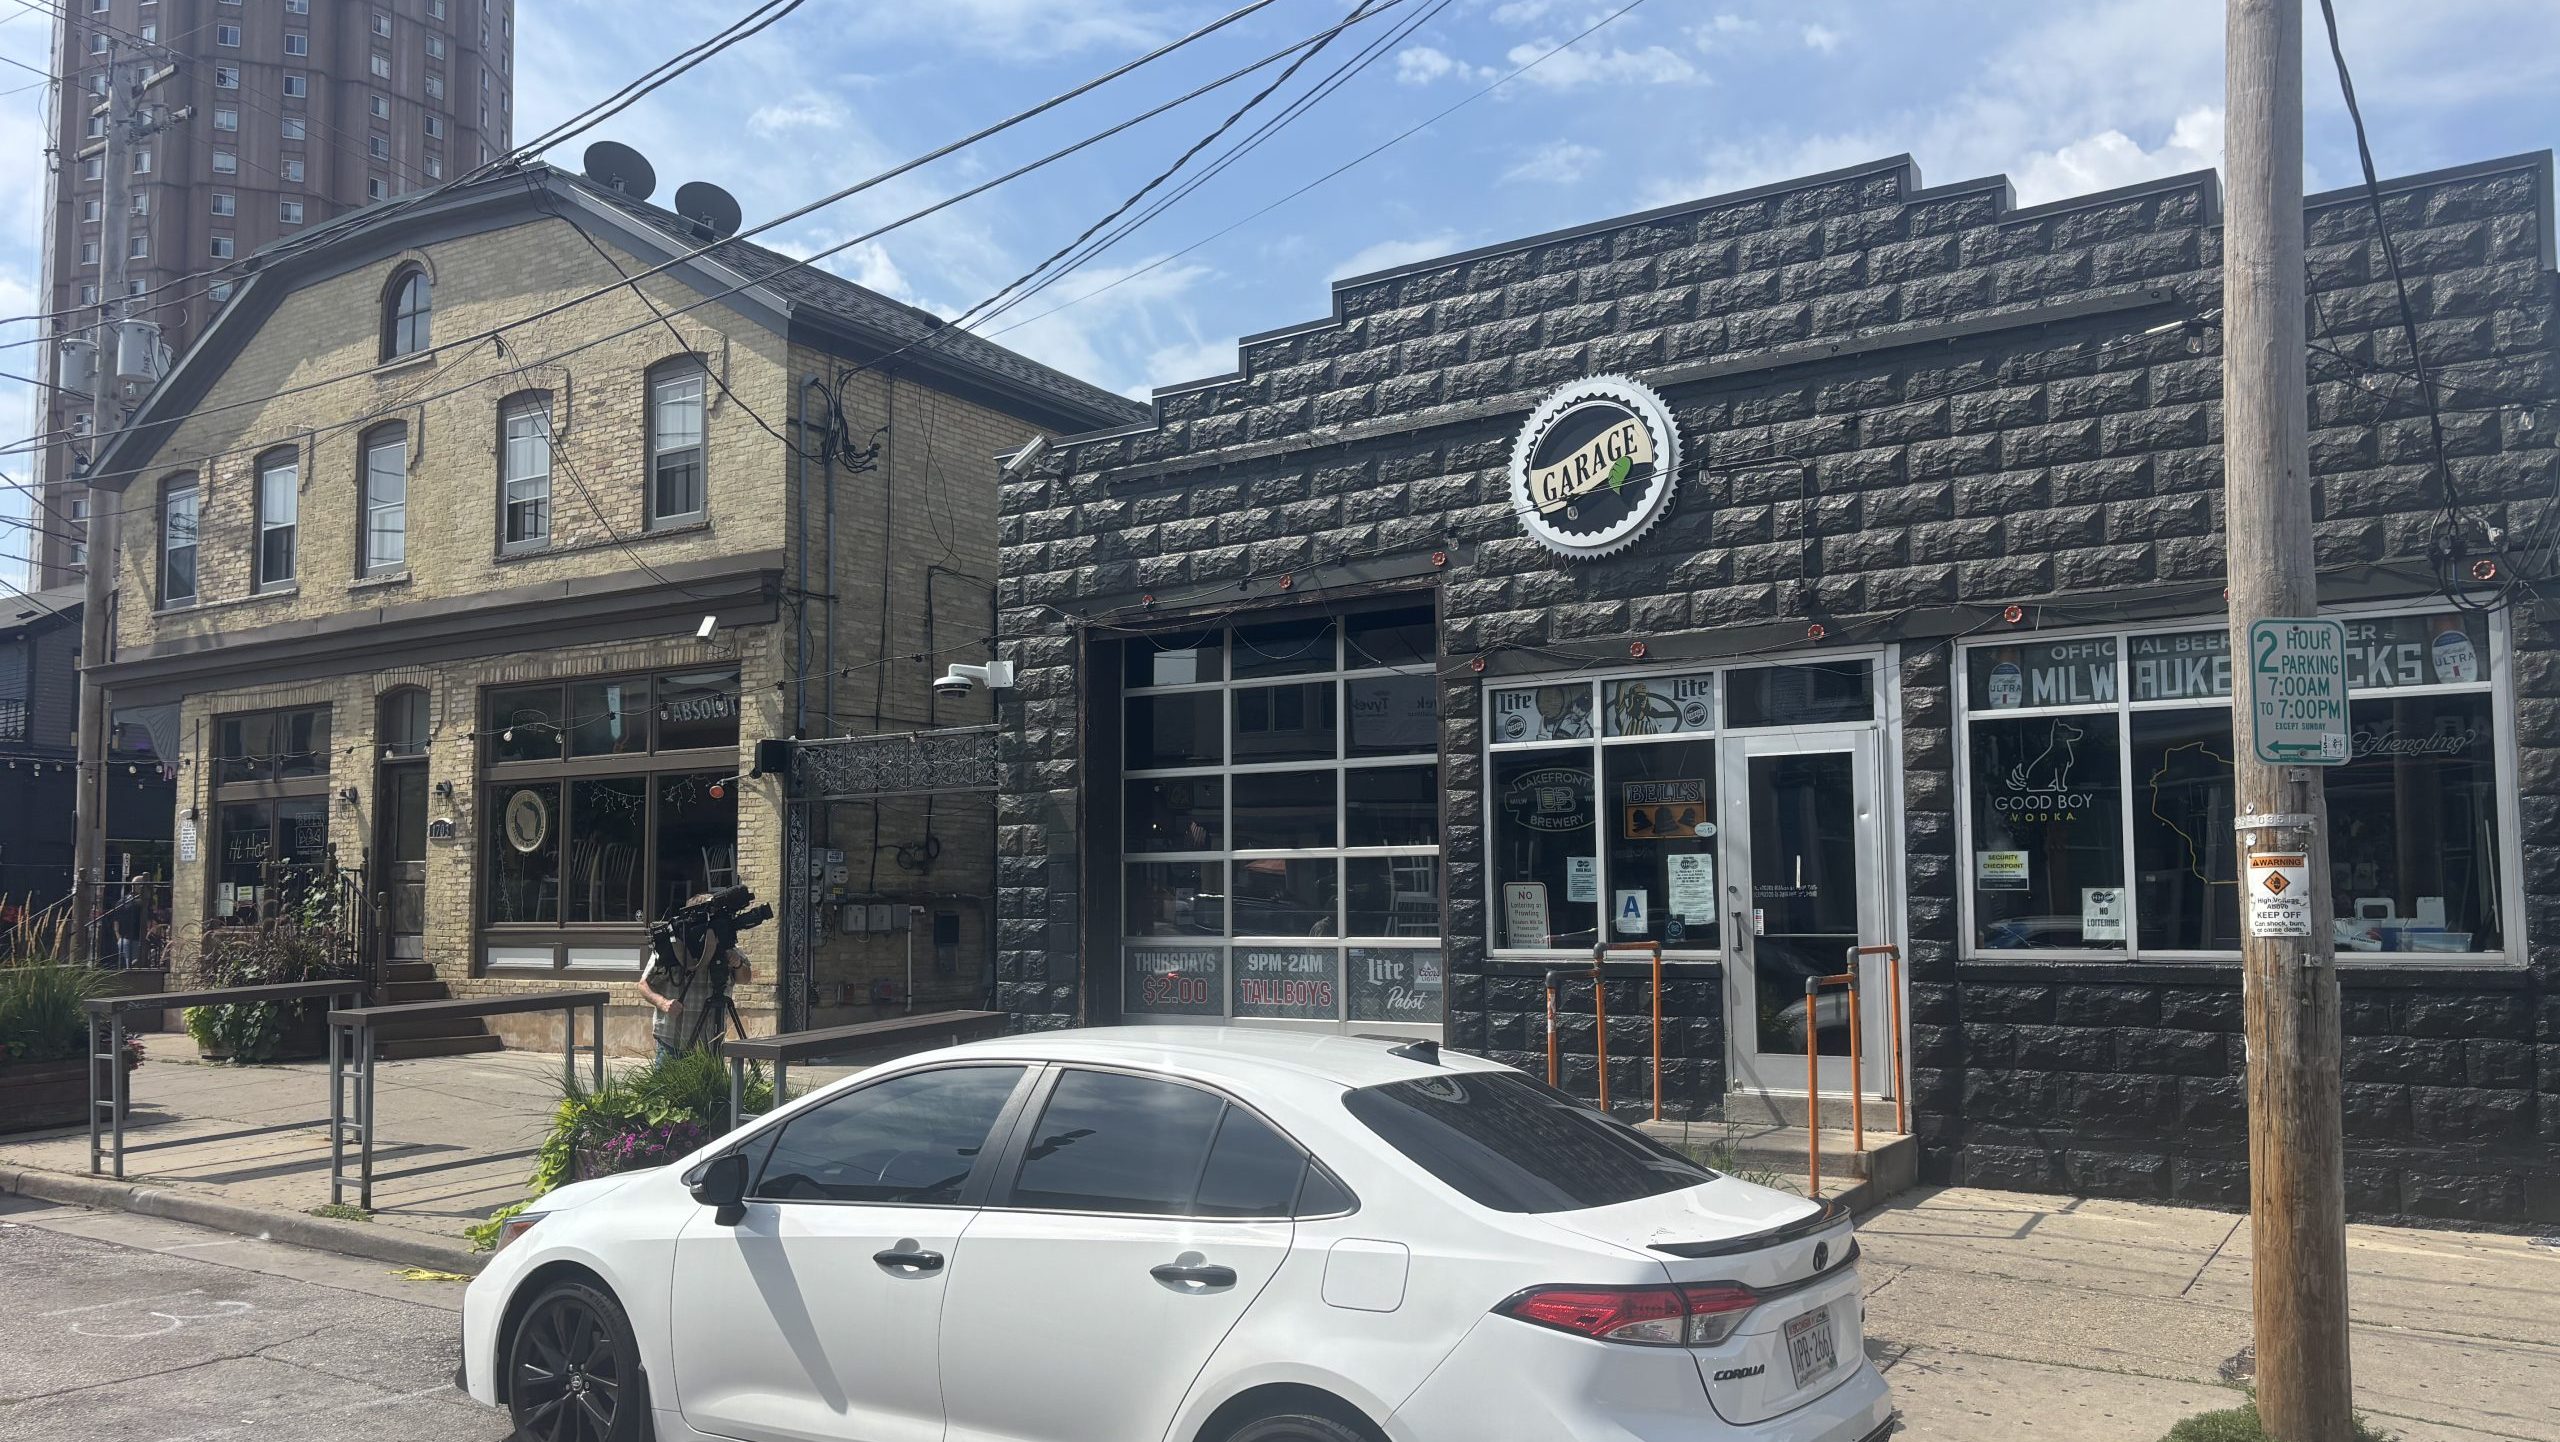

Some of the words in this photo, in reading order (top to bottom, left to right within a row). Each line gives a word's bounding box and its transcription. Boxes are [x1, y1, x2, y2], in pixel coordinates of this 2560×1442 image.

[1543, 424, 1638, 501] GARAGE
[2256, 630, 2279, 673] 2
[2286, 630, 2331, 650] HOUR
[2435, 652, 2475, 667] ULTRA
[2281, 654, 2339, 675] PARKING
[1672, 678, 1709, 702] Lite
[1990, 684, 2022, 693] ULTRA
[2268, 676, 2330, 697] 7:00AM
[673, 696, 736, 722] ABSOLUT
[1500, 693, 1532, 715] Lite
[2260, 702, 2274, 716] TO
[2278, 699, 2341, 719] 7:00PM
[2275, 721, 2300, 731] EXCEPT
[2301, 722, 2326, 731] SUNDAY
[2352, 729, 2476, 758] Yuengling
[1518, 772, 1591, 791] LAKEFRONT
[1628, 782, 1700, 804] BELL'S
[1995, 795, 2051, 811] GOOD
[2058, 793, 2093, 809] BOY
[1530, 812, 1584, 828] BREWERY
[2010, 812, 2076, 822] VODKA
[229, 836, 242, 862] Hi
[2259, 858, 2302, 867] WARNING
[1518, 891, 1533, 900] NO
[2257, 897, 2272, 905] High
[1514, 910, 1539, 918] Prowling
[1623, 895, 1641, 918] A
[2099, 907, 2109, 915] NO
[2257, 911, 2280, 919] KEEP
[2283, 911, 2302, 919] OFF
[2087, 918, 2120, 927] LOITERING
[1134, 952, 1216, 973] THURSDAYS
[1248, 953, 1323, 973] 9PM-2AM
[1366, 957, 1404, 985] Lite
[1418, 967, 1440, 977] Coors
[1143, 974, 1209, 1005] $2.00
[1241, 979, 1332, 1007] TALLBOYS
[1387, 985, 1428, 1010] Pabst
[1714, 1364, 1765, 1381] COROLLA
